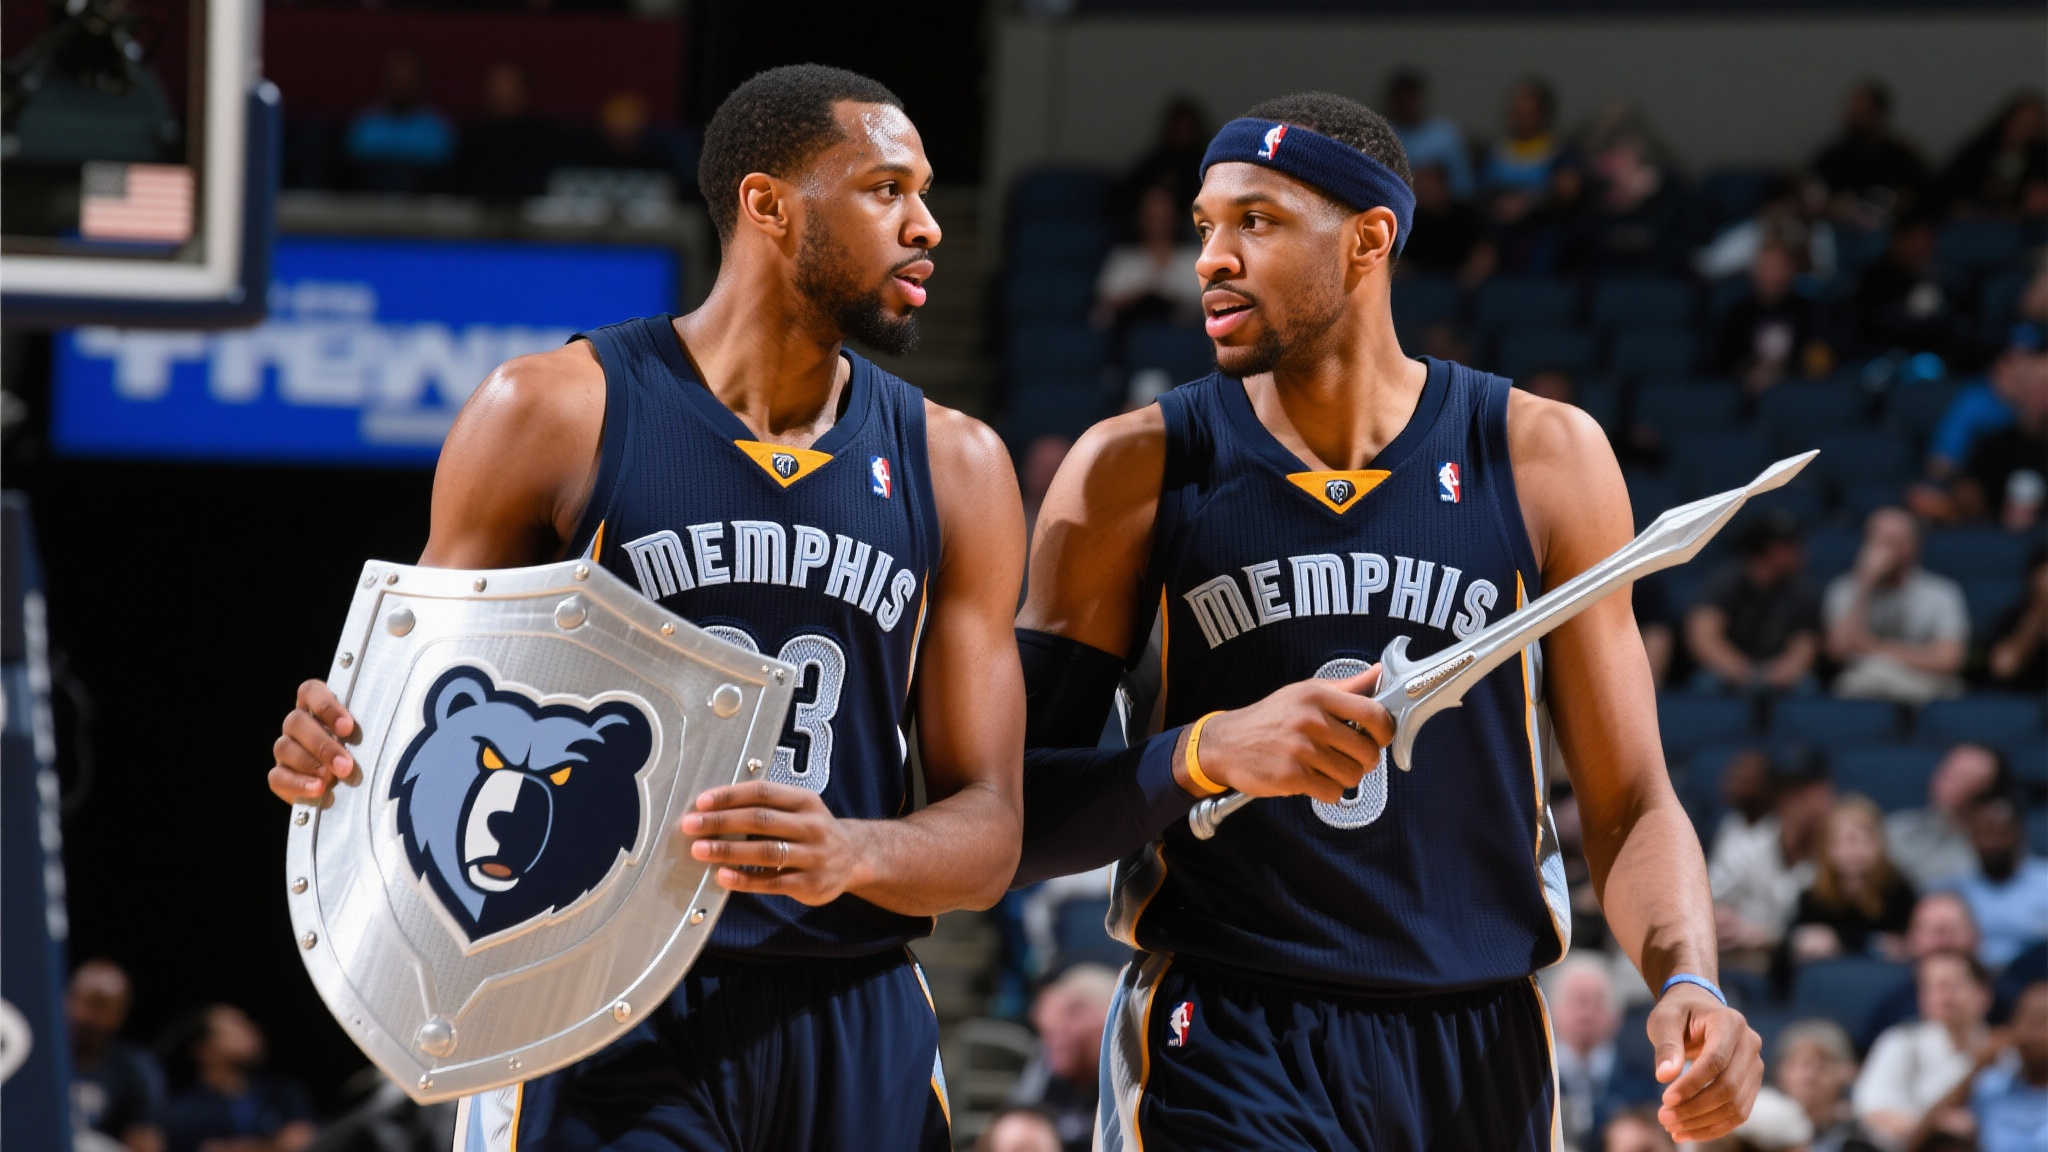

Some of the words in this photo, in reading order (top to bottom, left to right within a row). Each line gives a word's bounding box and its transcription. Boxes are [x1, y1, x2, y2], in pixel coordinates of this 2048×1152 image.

[620, 520, 917, 632] MEMPHIS
[1183, 552, 1499, 650] MEMPHIS
[701, 625, 846, 796] 3
